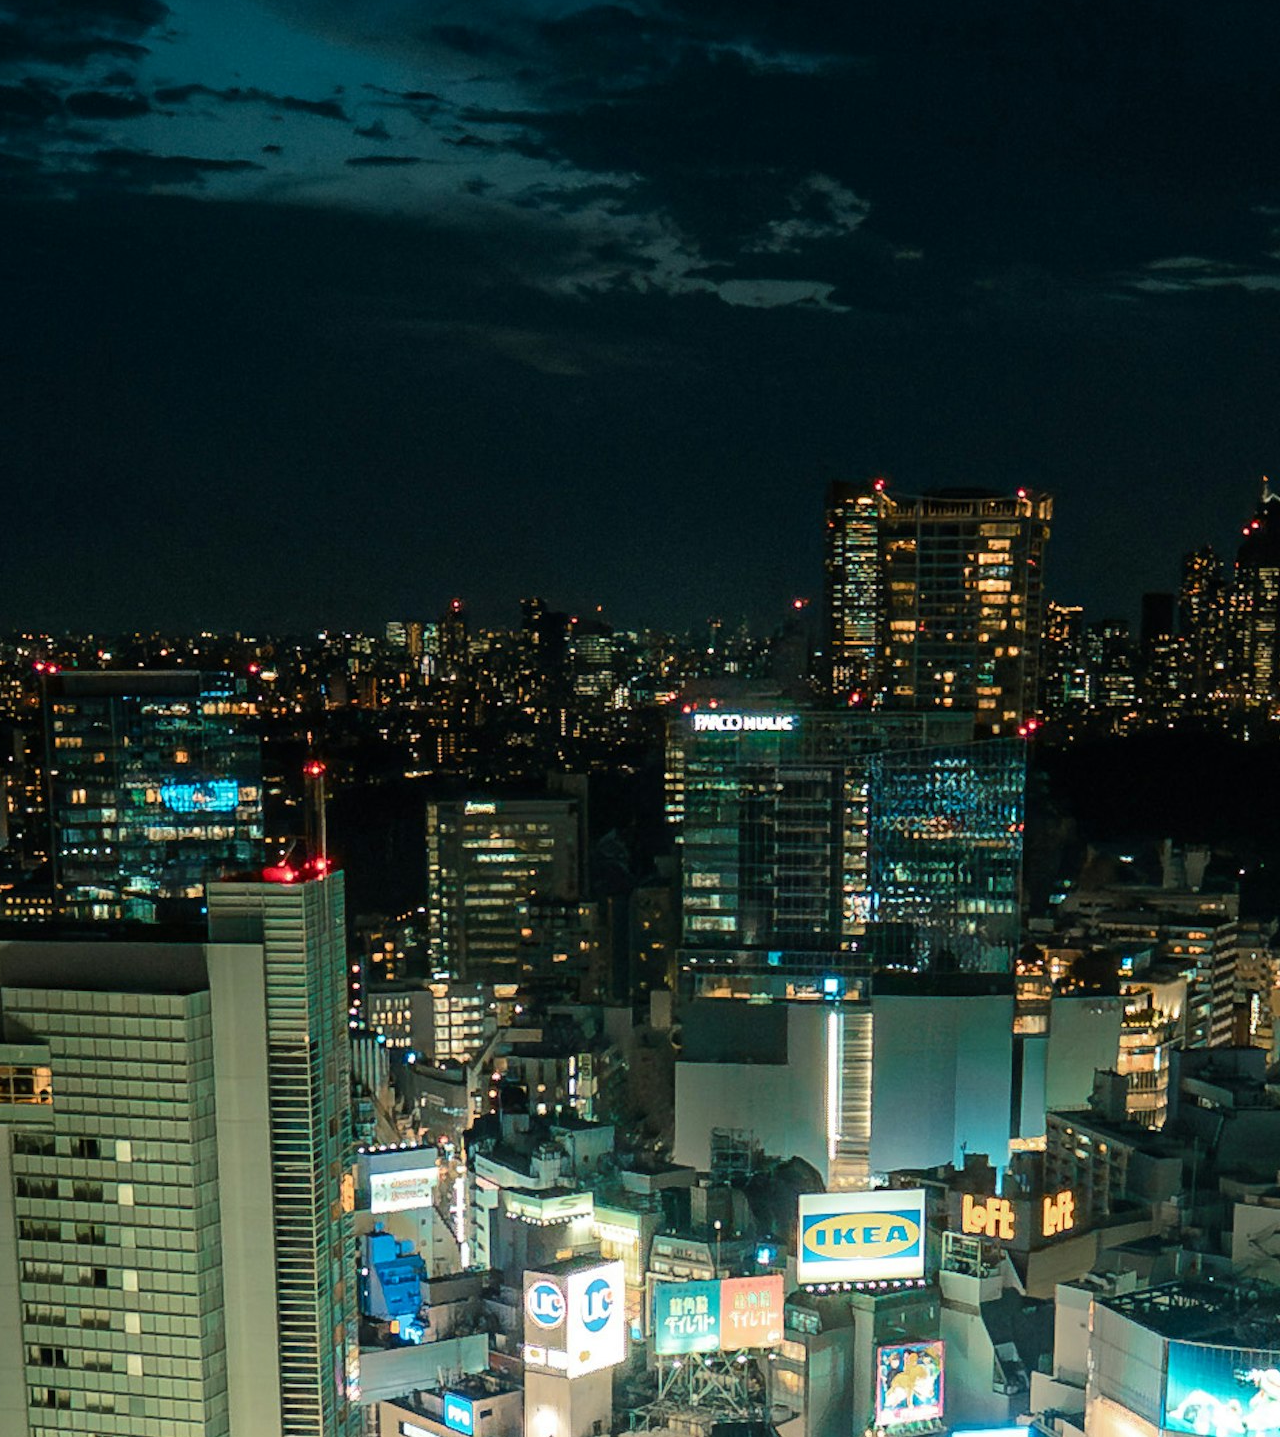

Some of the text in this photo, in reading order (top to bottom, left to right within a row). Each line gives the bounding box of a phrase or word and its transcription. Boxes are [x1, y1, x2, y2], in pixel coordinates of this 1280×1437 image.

[694, 713, 794, 732] PARCO HULIC
[815, 1225, 910, 1247] IKEA
